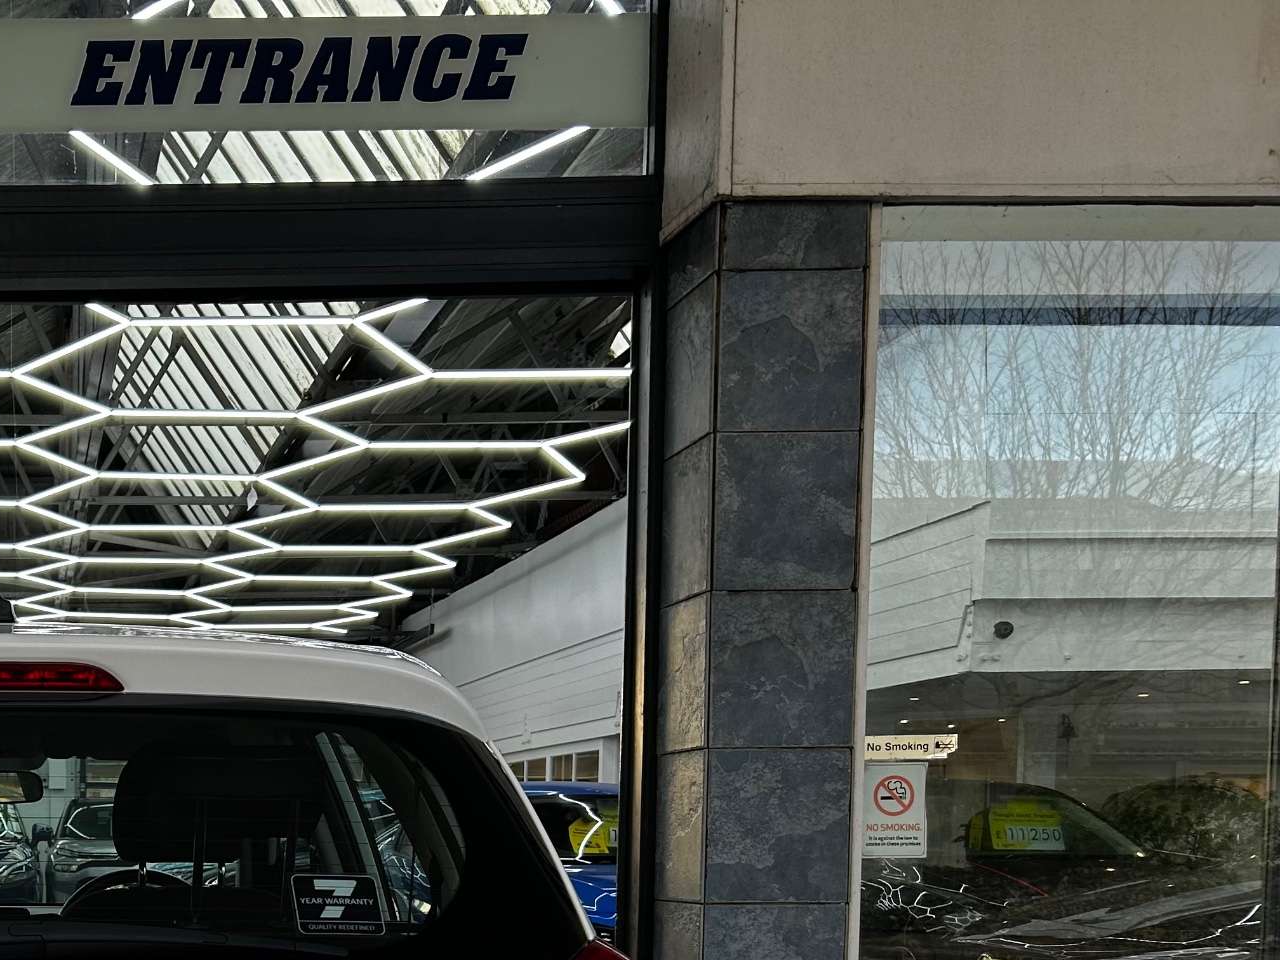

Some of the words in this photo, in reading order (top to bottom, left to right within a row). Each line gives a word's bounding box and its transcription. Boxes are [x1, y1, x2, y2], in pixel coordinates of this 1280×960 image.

[70, 33, 529, 106] ENTRANCE
[866, 743, 882, 752] No
[884, 742, 929, 753] Smoking
[866, 824, 879, 832] NO
[300, 897, 322, 905] YEAR
[325, 898, 374, 906] WARRANTY
